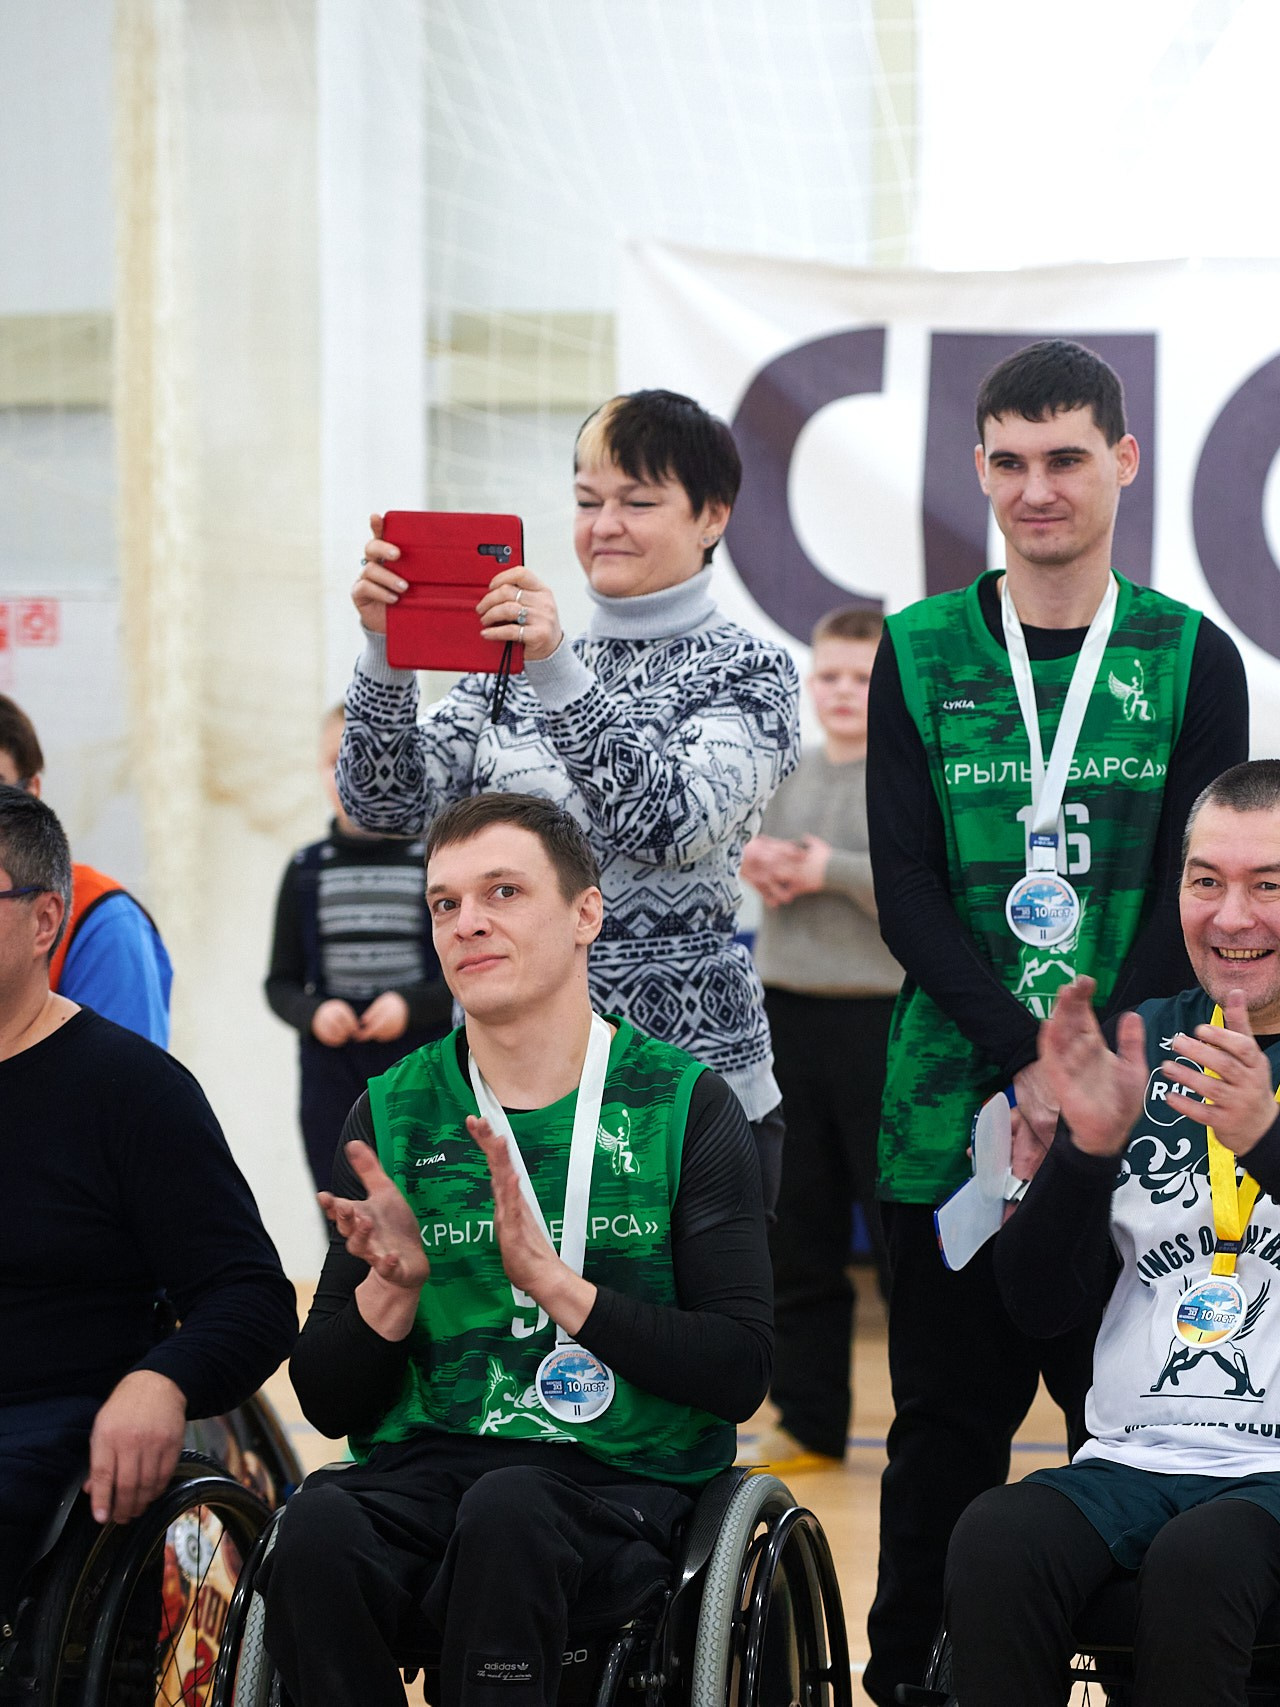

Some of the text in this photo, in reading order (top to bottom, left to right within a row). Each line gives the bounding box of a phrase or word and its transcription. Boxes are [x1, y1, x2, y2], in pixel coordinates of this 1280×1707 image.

[943, 699, 976, 710] LYKIA
[945, 761, 1049, 785] РЫЛЬ
[1016, 802, 1092, 876] 16
[1034, 906, 1048, 918] 10
[415, 1153, 446, 1167] LYKIA
[418, 1220, 494, 1247] КРЫЛ
[1200, 1309, 1213, 1321] 10
[567, 1381, 581, 1393] 10
[484, 1662, 517, 1671] adidas
